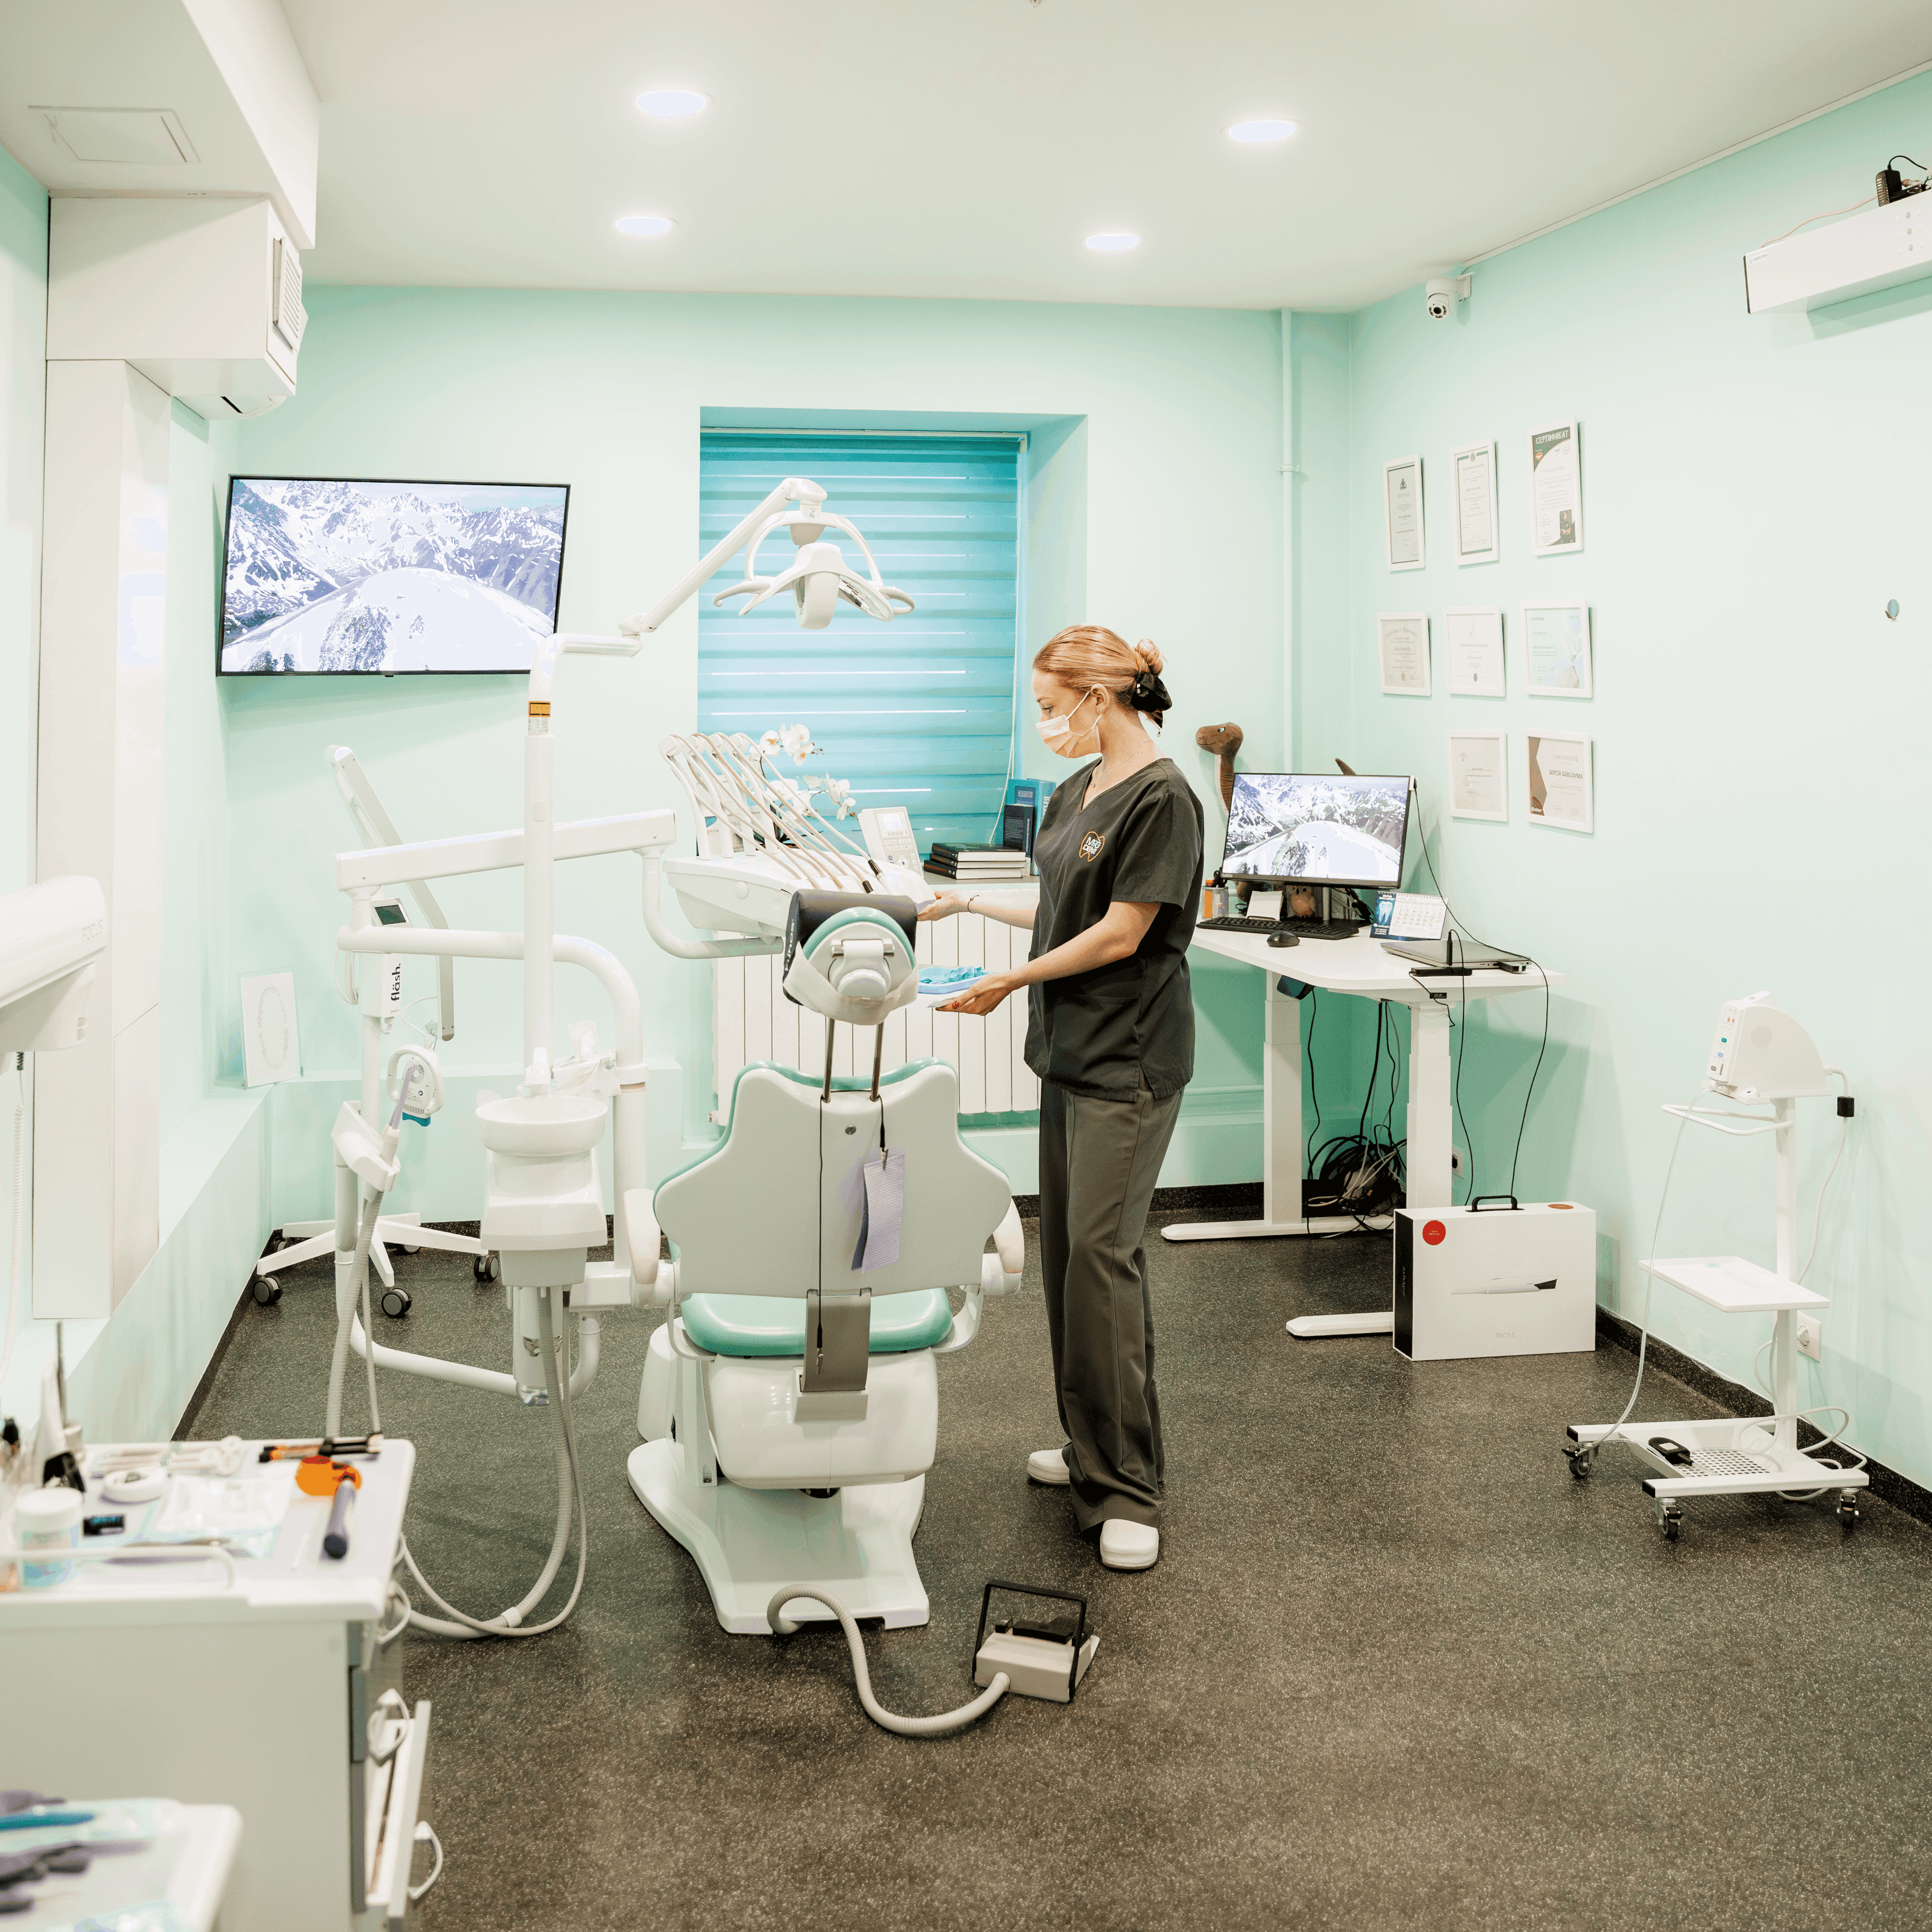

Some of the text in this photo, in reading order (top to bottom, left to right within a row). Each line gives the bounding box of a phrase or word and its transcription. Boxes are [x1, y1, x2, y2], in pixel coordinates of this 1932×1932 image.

[1536, 430, 1568, 444] СЕРТИФИКАТ
[1562, 771, 1583, 779] GASILOVSKA
[1082, 844, 1097, 854] DENT
[83, 920, 104, 942] FOCUS
